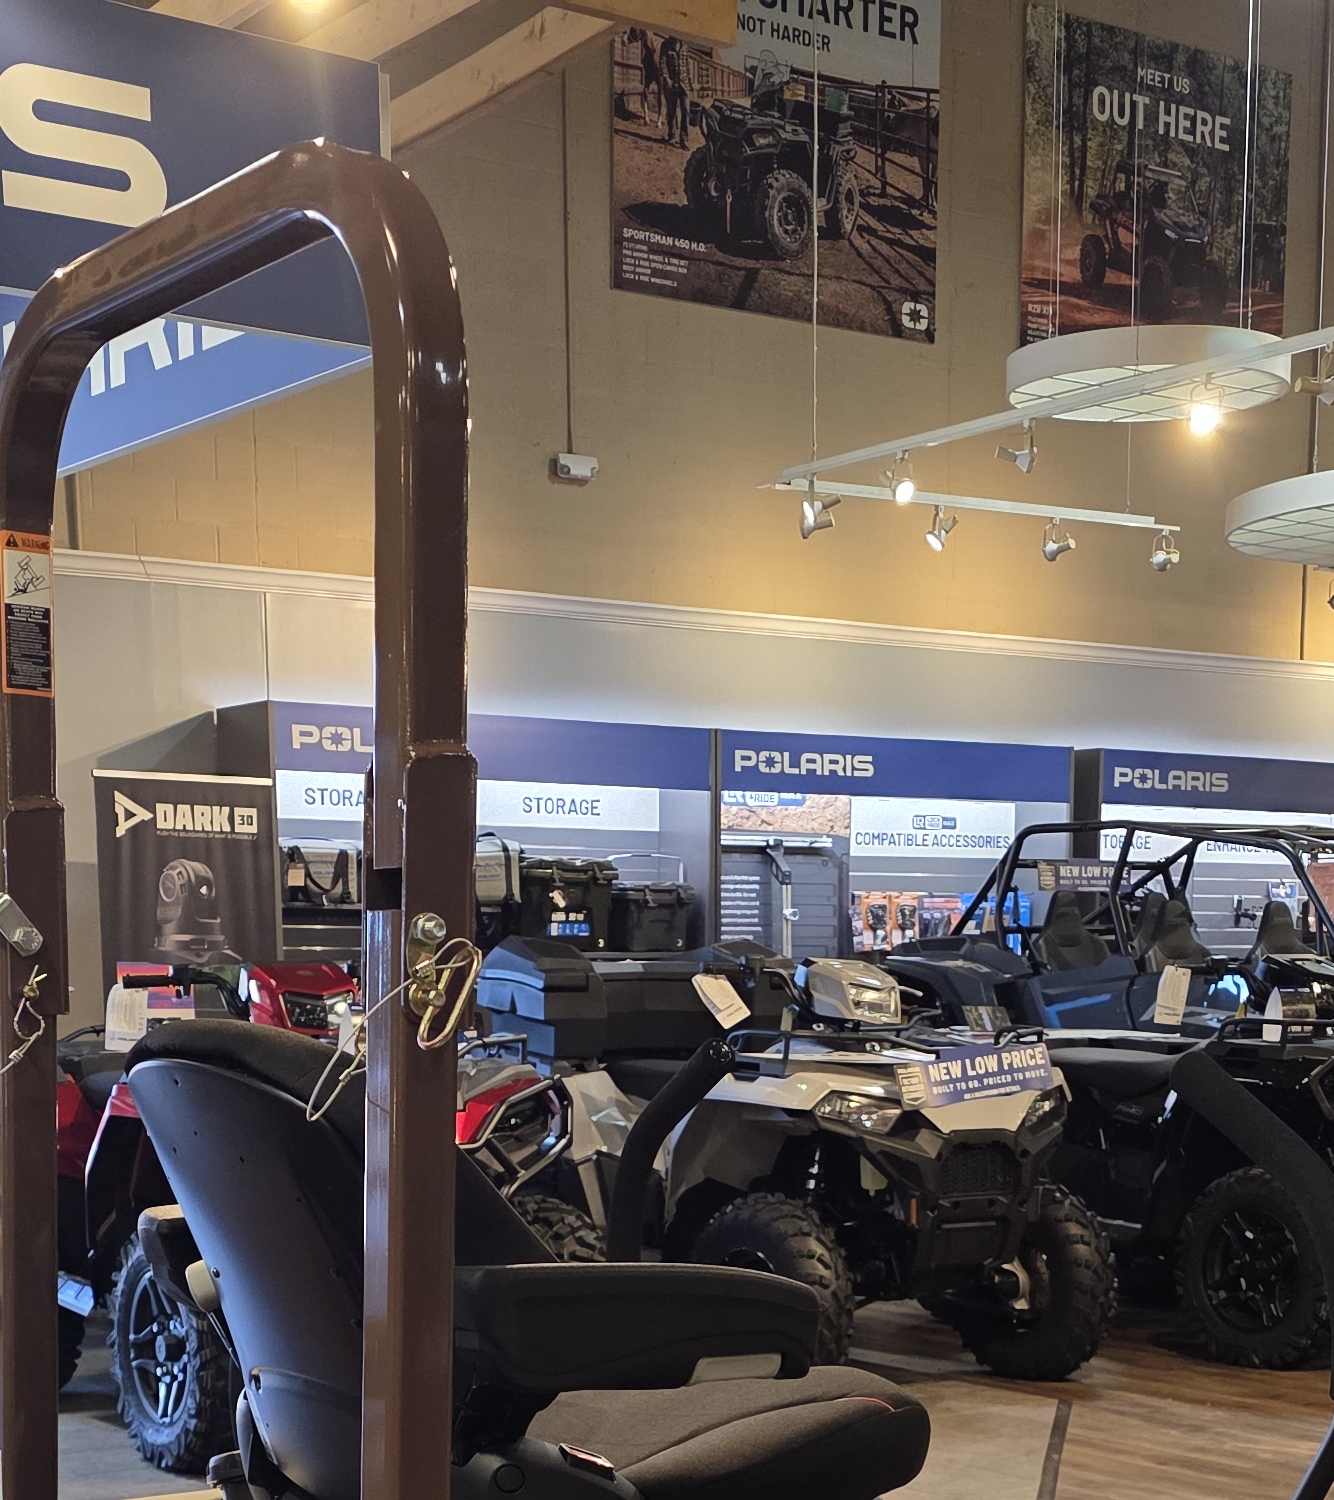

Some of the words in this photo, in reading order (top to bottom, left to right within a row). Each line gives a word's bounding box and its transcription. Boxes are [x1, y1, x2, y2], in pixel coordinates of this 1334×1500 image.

[737, 13, 765, 36] NOT
[770, 21, 831, 53] HARDER
[761, 0, 919, 45] ARTER
[1137, 67, 1173, 90] MEET
[1174, 75, 1191, 95] US
[1091, 86, 1149, 134] OUT
[1157, 103, 1231, 153] HERE
[622, 227, 673, 247] SPORTSMAN
[674, 237, 690, 250] 450
[734, 749, 875, 778] POLARIS
[1113, 766, 1229, 793] POLARIS
[304, 787, 365, 807] STORA
[522, 796, 601, 816] STORAGE
[155, 802, 231, 832] DARK
[854, 832, 929, 847] COMPATIBLE
[931, 833, 1011, 849] ACCESSORIES
[1060, 865, 1080, 877] NEW
[1081, 866, 1101, 877] LOW
[1102, 866, 1129, 878] PRE
[928, 1059, 962, 1082] NEW
[965, 1054, 998, 1076] LOW
[1001, 1047, 1046, 1070] PRICE
[932, 1084, 954, 1095] BUILT
[956, 1082, 966, 1090] TO
[983, 1075, 1012, 1086] PRICED
[1013, 1073, 1024, 1081] TO
[1025, 1069, 1048, 1079] MOVE.
